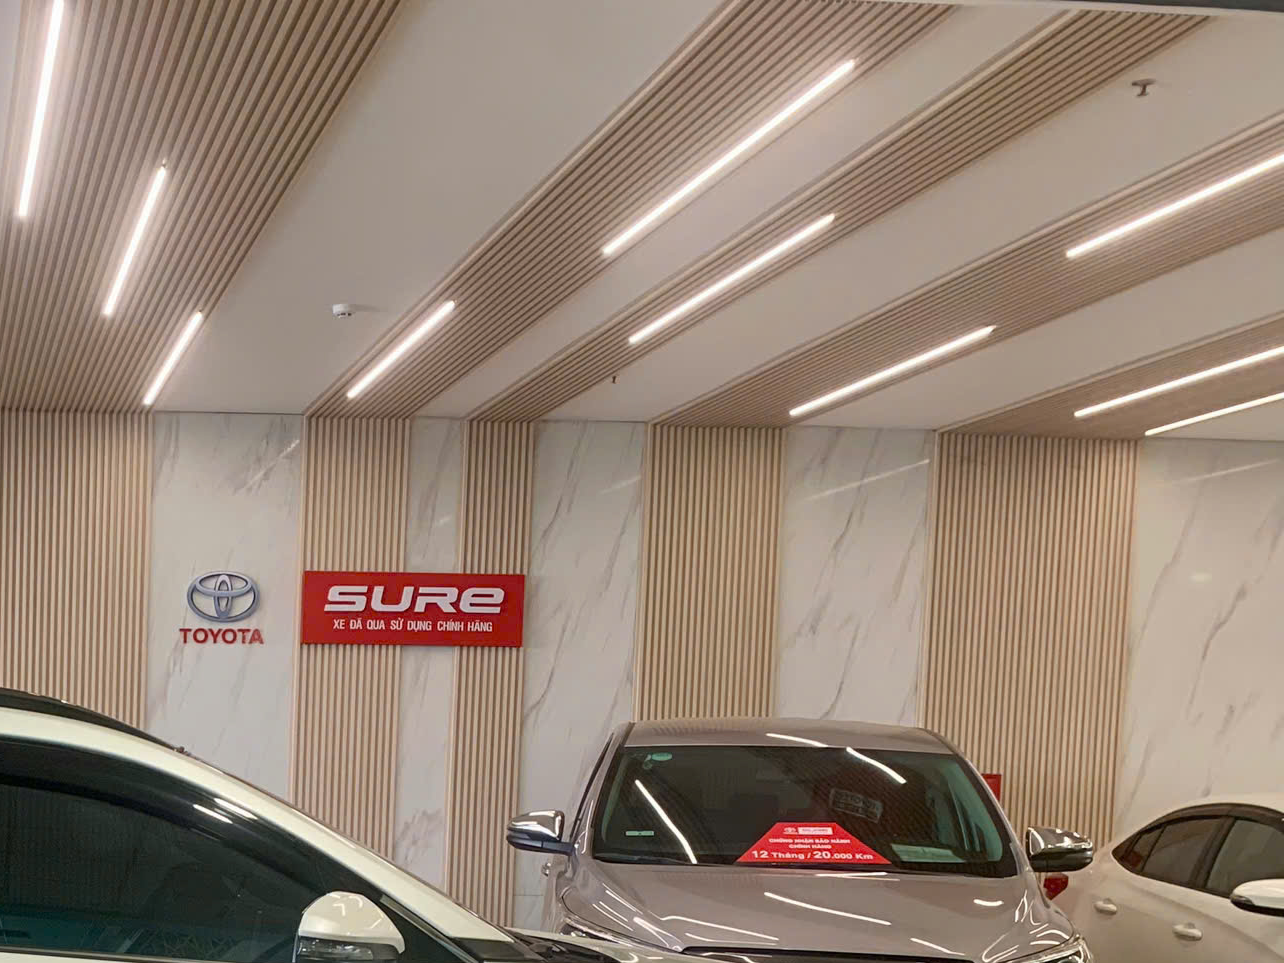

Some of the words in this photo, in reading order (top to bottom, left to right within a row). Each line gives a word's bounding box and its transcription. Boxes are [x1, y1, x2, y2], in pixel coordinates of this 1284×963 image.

[333, 619, 345, 630] XE
[349, 617, 362, 630] ĐÃ
[367, 619, 385, 631] QUA
[407, 620, 432, 632] DỤNG
[437, 618, 464, 632] CHÍNH
[467, 619, 493, 632] HÃNG
[179, 628, 264, 644] TOYOTA
[813, 850, 852, 859] 20.000
